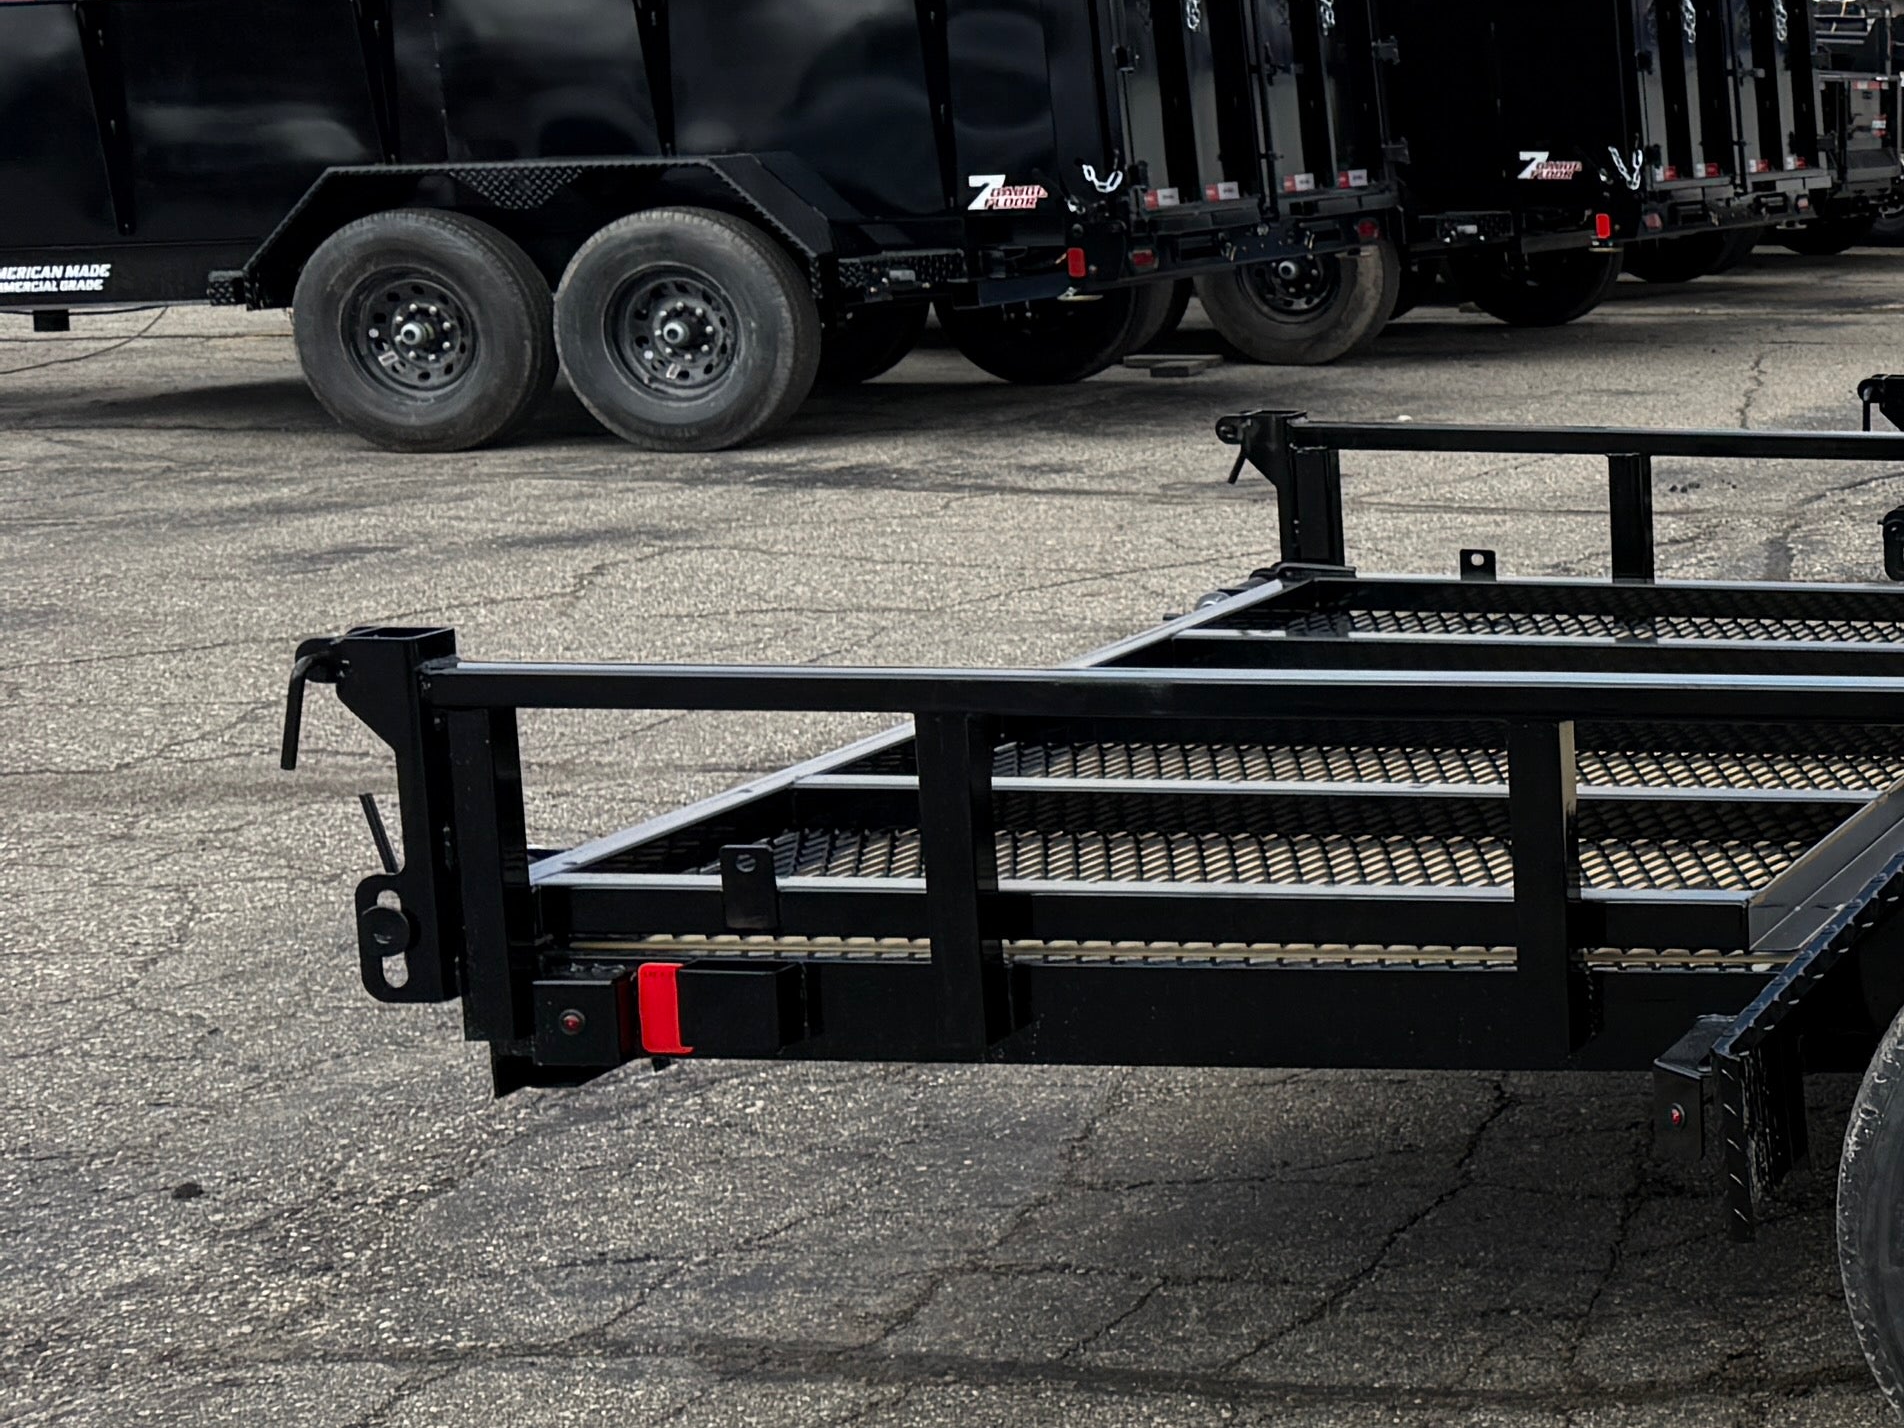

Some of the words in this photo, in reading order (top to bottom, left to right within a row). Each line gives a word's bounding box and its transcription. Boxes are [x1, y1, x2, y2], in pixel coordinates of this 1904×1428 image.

[1517, 151, 1549, 179] 7
[967, 174, 1006, 210] 7
[65, 264, 111, 278] MADE
[60, 279, 104, 292] GRADE
